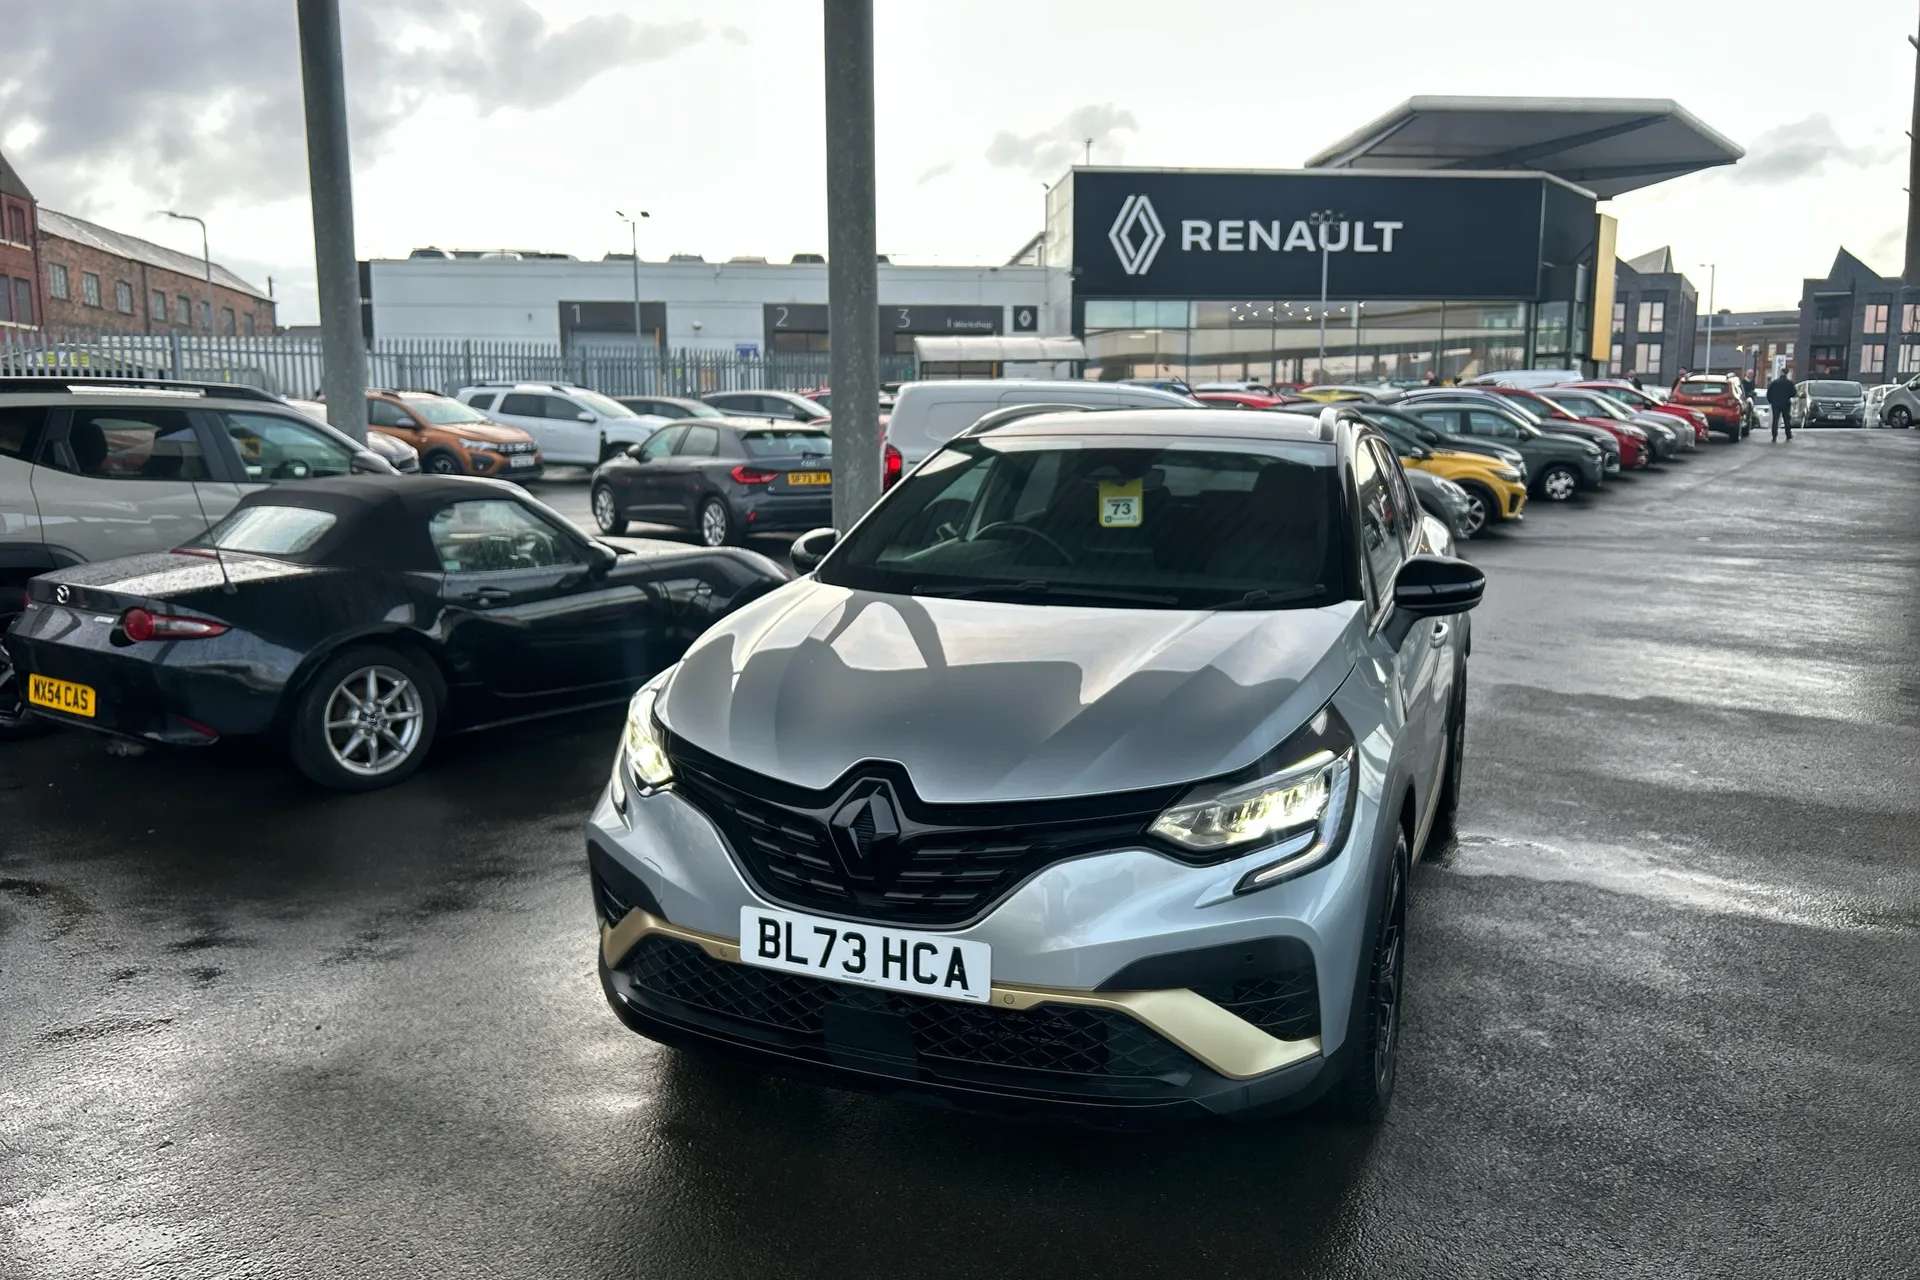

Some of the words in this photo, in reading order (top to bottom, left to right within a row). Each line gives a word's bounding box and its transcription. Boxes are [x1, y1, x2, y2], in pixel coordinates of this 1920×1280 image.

[1181, 219, 1404, 252] RENAULT
[571, 304, 581, 323] 1
[775, 306, 789, 328] 2
[897, 308, 911, 328] 3
[1110, 503, 1132, 516] 73
[33, 678, 61, 704] MX54
[64, 686, 88, 710] CAS
[757, 916, 867, 974] BL73
[882, 936, 970, 991] HCA
